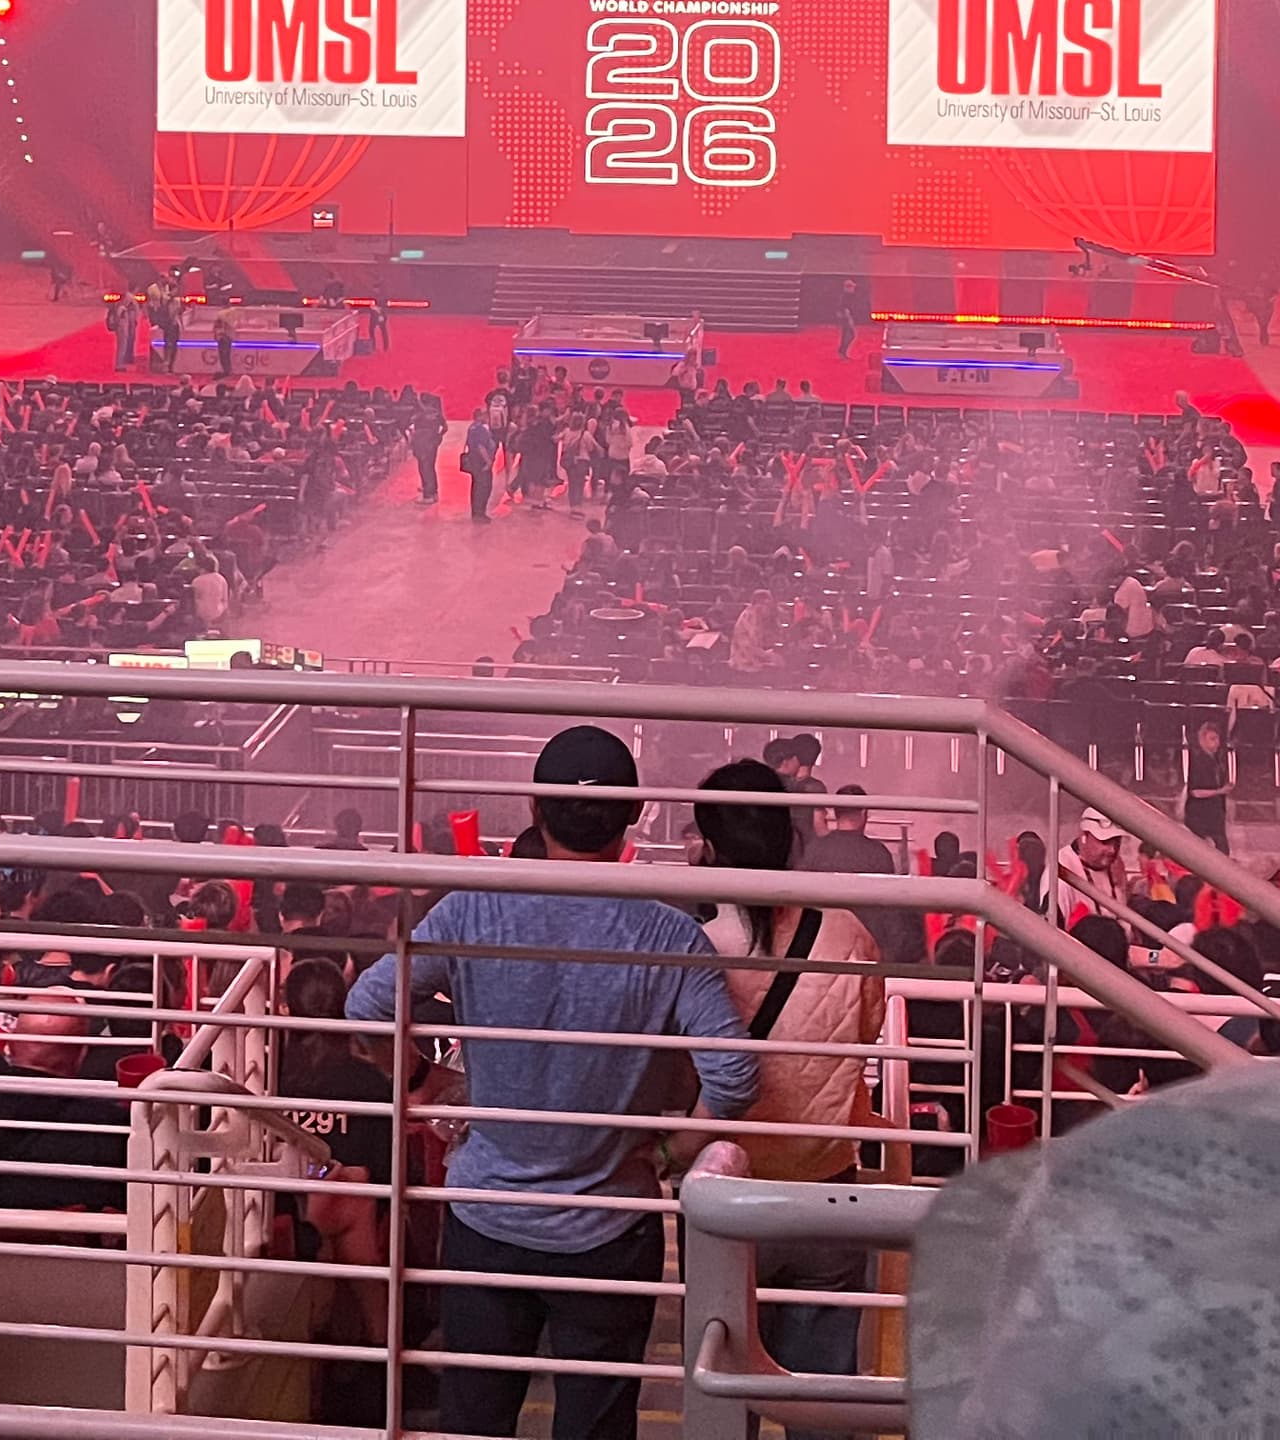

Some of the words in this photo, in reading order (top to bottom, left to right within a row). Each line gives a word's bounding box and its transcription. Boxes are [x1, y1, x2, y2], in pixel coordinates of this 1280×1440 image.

[589, 0, 649, 13] WORLD
[652, 0, 780, 15] CHAMPIONSHIP
[585, 17, 781, 103] 20
[204, 86, 273, 109] University
[275, 87, 288, 106] of
[382, 88, 417, 108] Louis
[936, 98, 1008, 122] University
[1010, 100, 1024, 119] of
[1124, 102, 1161, 122] Louis
[584, 102, 777, 187] 26
